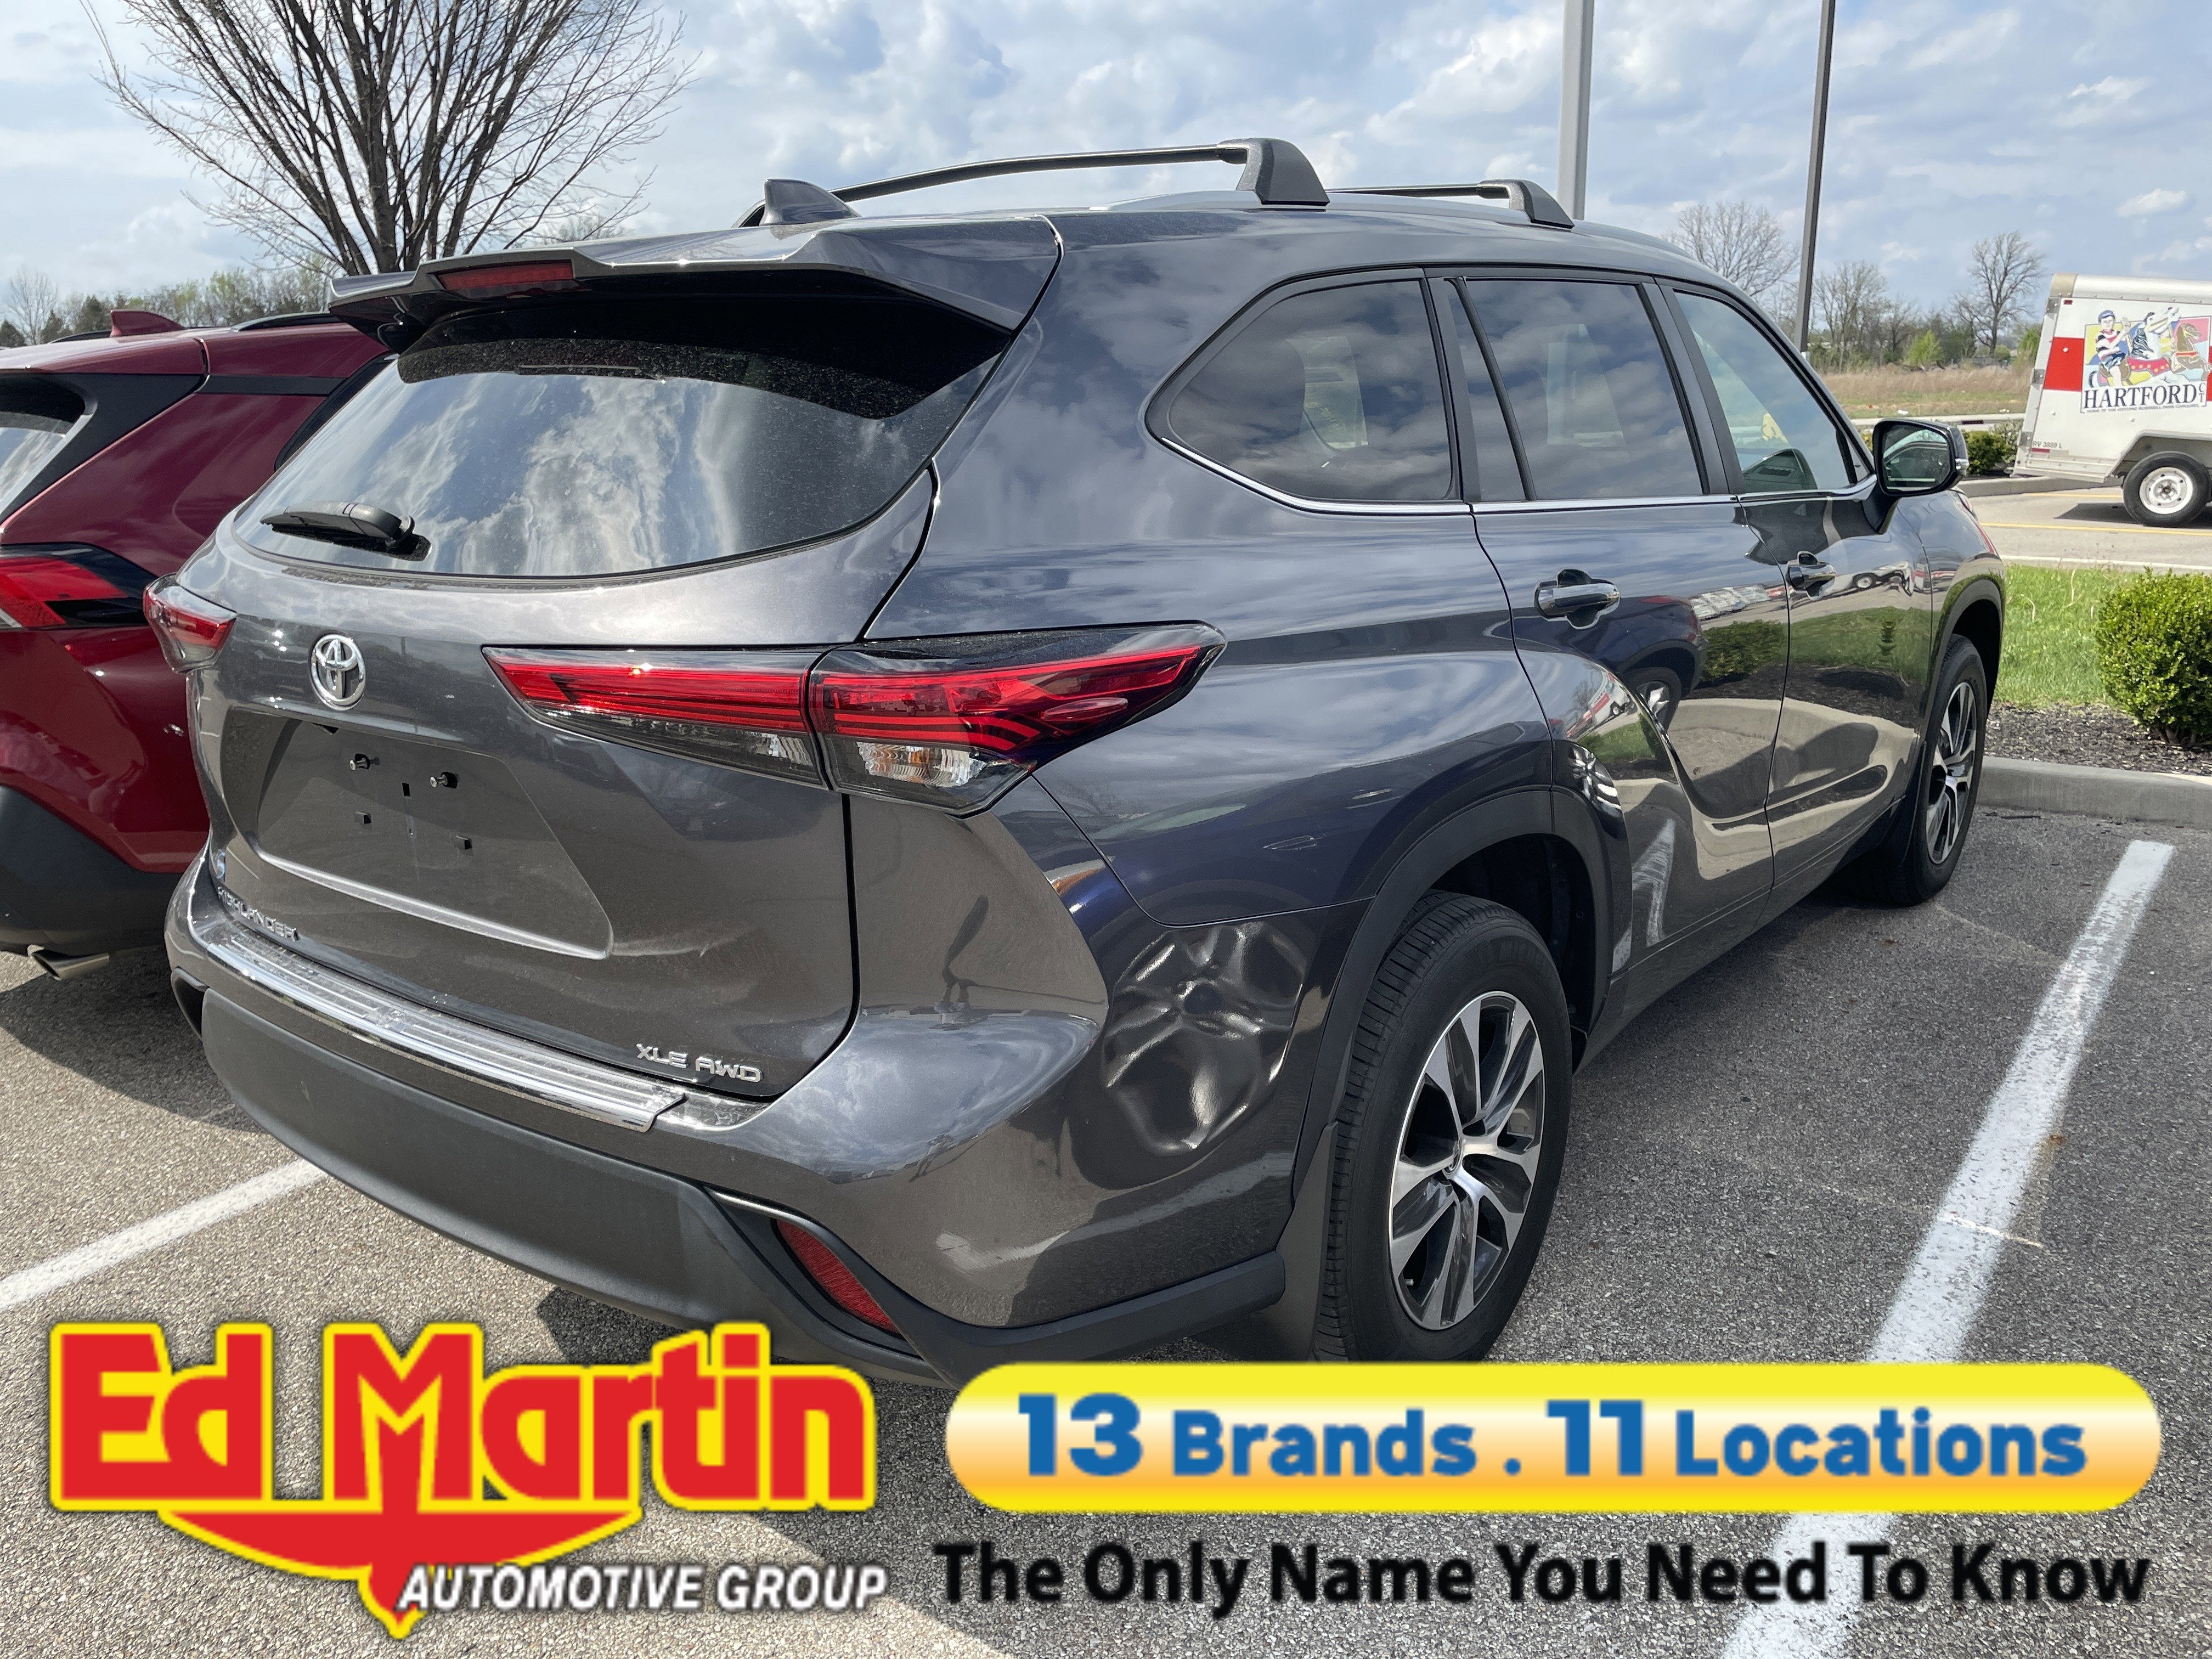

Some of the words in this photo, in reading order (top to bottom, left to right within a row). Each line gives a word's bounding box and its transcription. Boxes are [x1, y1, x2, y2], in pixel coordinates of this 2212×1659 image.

[2083, 384, 2197, 409] HARTFORD
[636, 1043, 688, 1069] XLE
[695, 1056, 763, 1082] AWD
